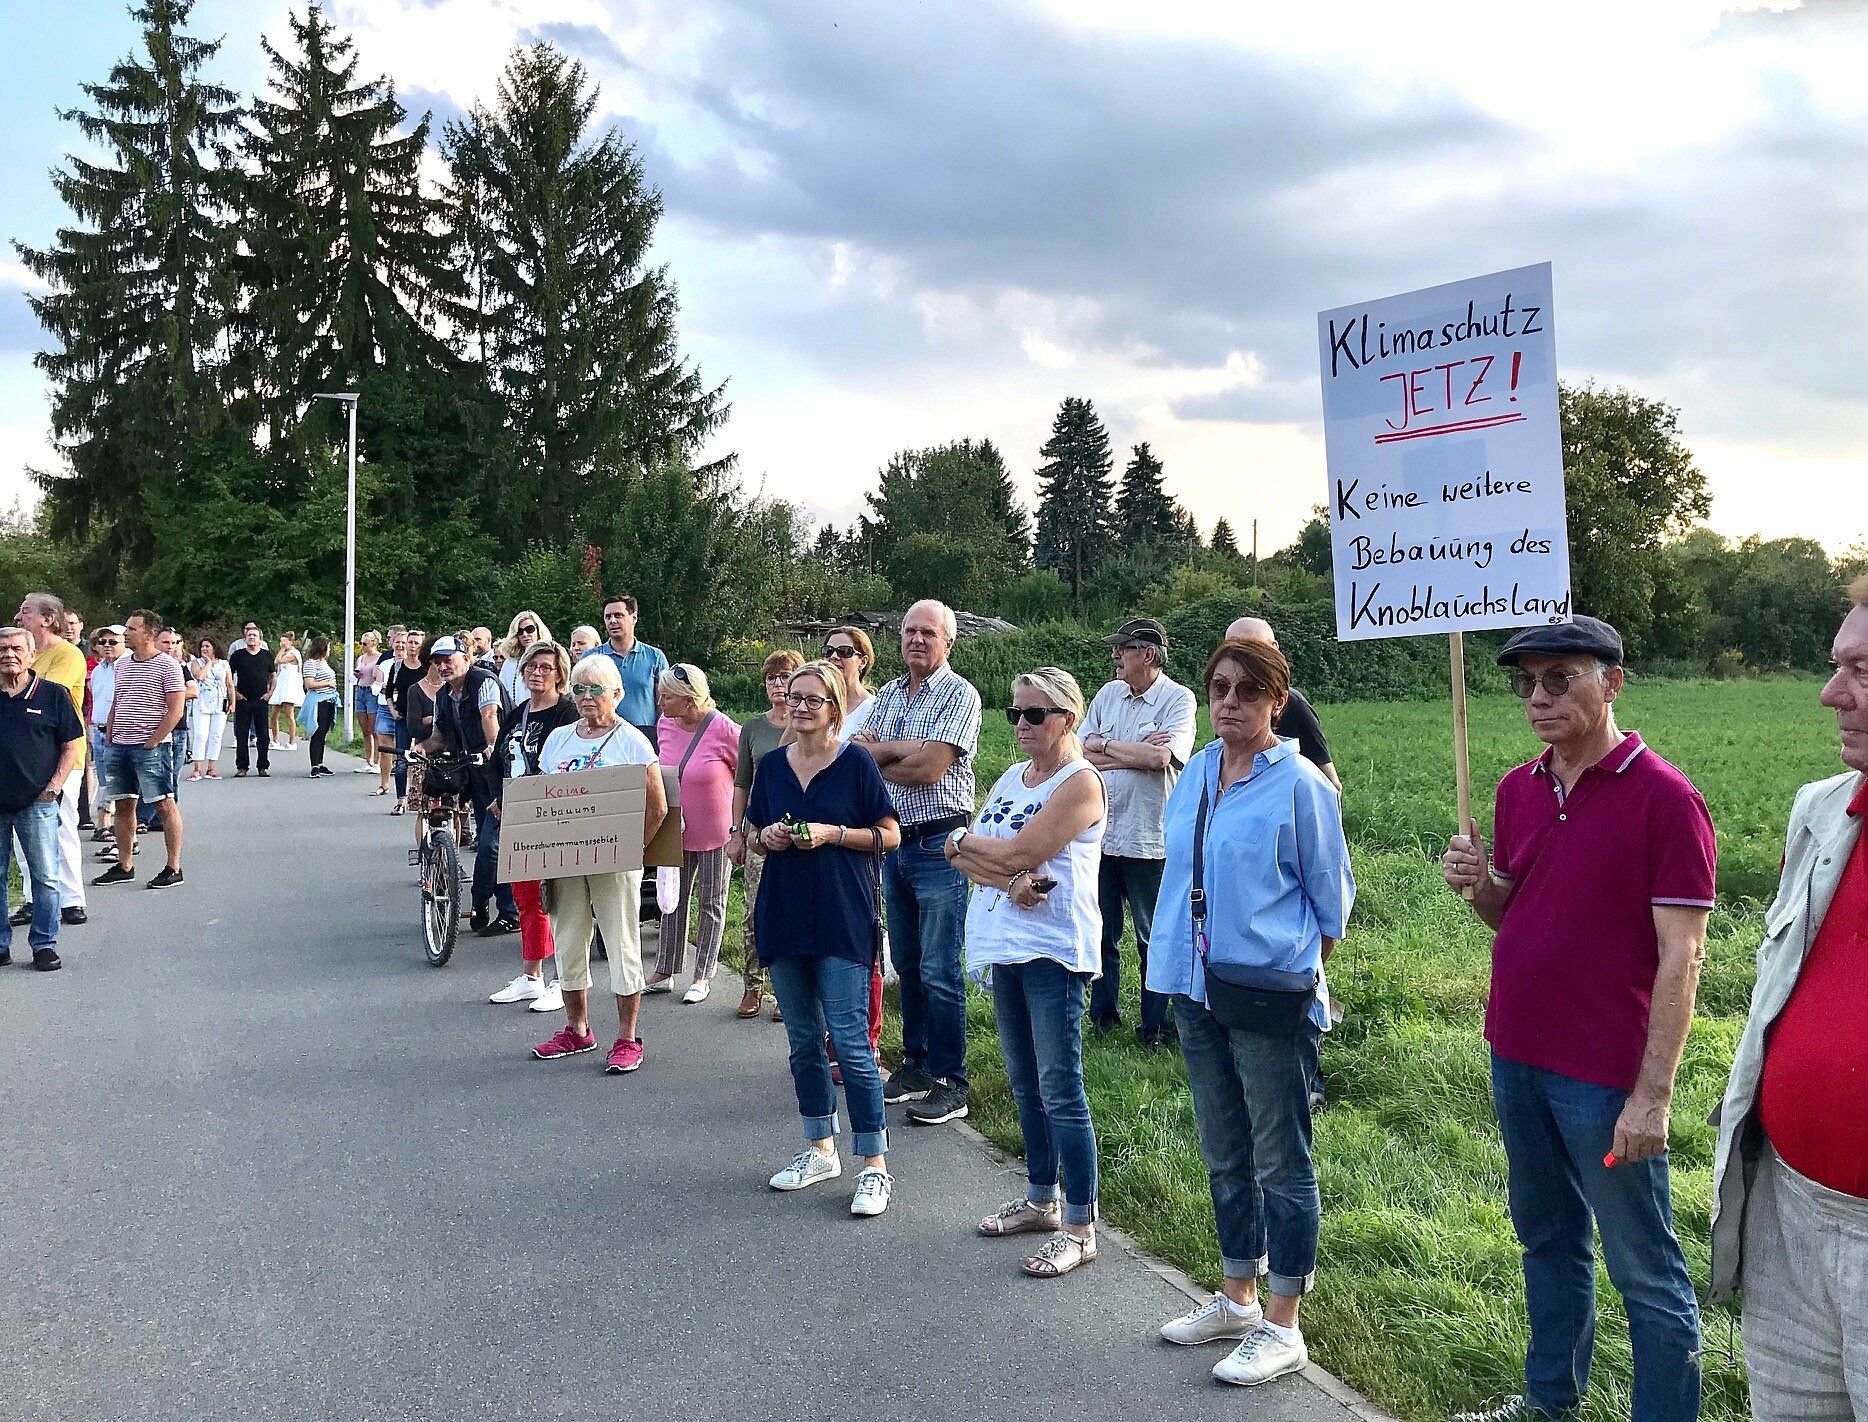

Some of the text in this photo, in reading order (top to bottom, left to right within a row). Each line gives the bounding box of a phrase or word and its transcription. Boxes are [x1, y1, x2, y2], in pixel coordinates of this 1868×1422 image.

[1329, 293, 1543, 378] Klimaschutz
[1337, 470, 1532, 521] Keine weitere
[1510, 528, 1551, 554] des
[545, 785, 589, 800] Keine
[535, 805, 596, 819] Bebauung
[556, 818, 570, 826] im
